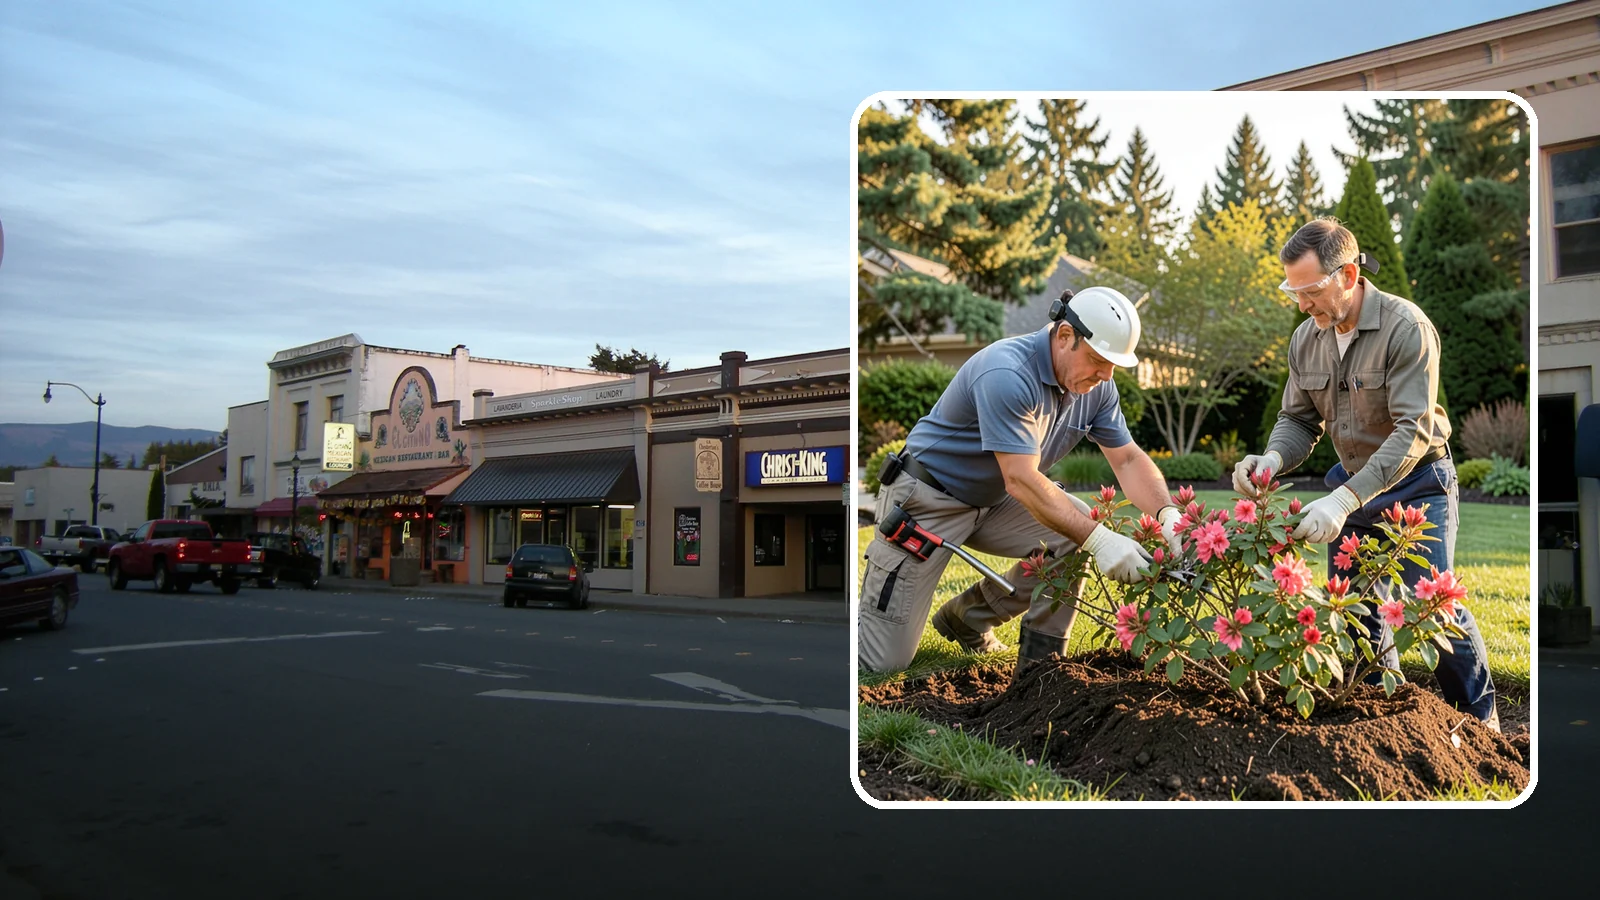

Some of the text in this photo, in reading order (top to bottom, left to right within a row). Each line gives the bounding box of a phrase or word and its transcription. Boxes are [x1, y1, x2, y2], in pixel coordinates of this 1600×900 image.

[493, 388, 624, 413] LAVANDERIA Sparkle Shop LAUNDRY
[391, 425, 401, 449] EL
[373, 450, 450, 464] MEXICAN RESTAURANT BAR
[760, 450, 828, 478] CHRIST KING
